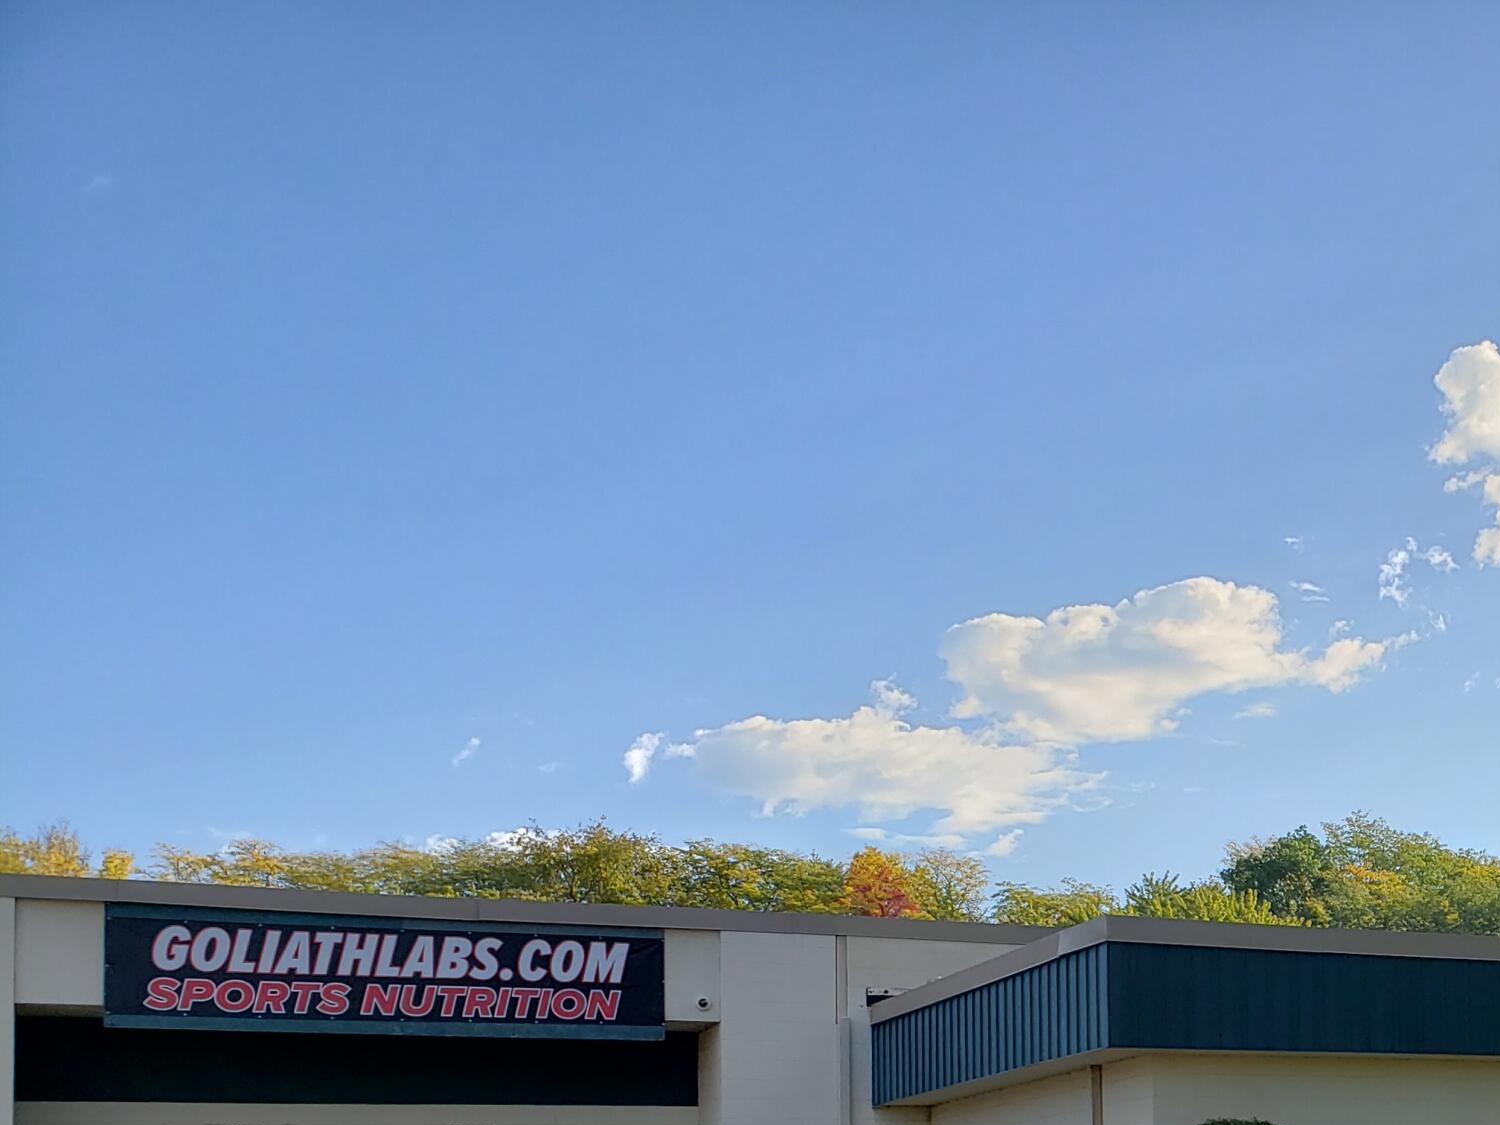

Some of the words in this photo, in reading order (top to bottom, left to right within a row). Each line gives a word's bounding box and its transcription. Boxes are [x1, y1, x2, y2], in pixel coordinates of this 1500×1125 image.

[151, 924, 630, 984] GOLIATHLABS.COM
[143, 977, 352, 1015] SPORTS
[359, 983, 622, 1020] NUTRITION
